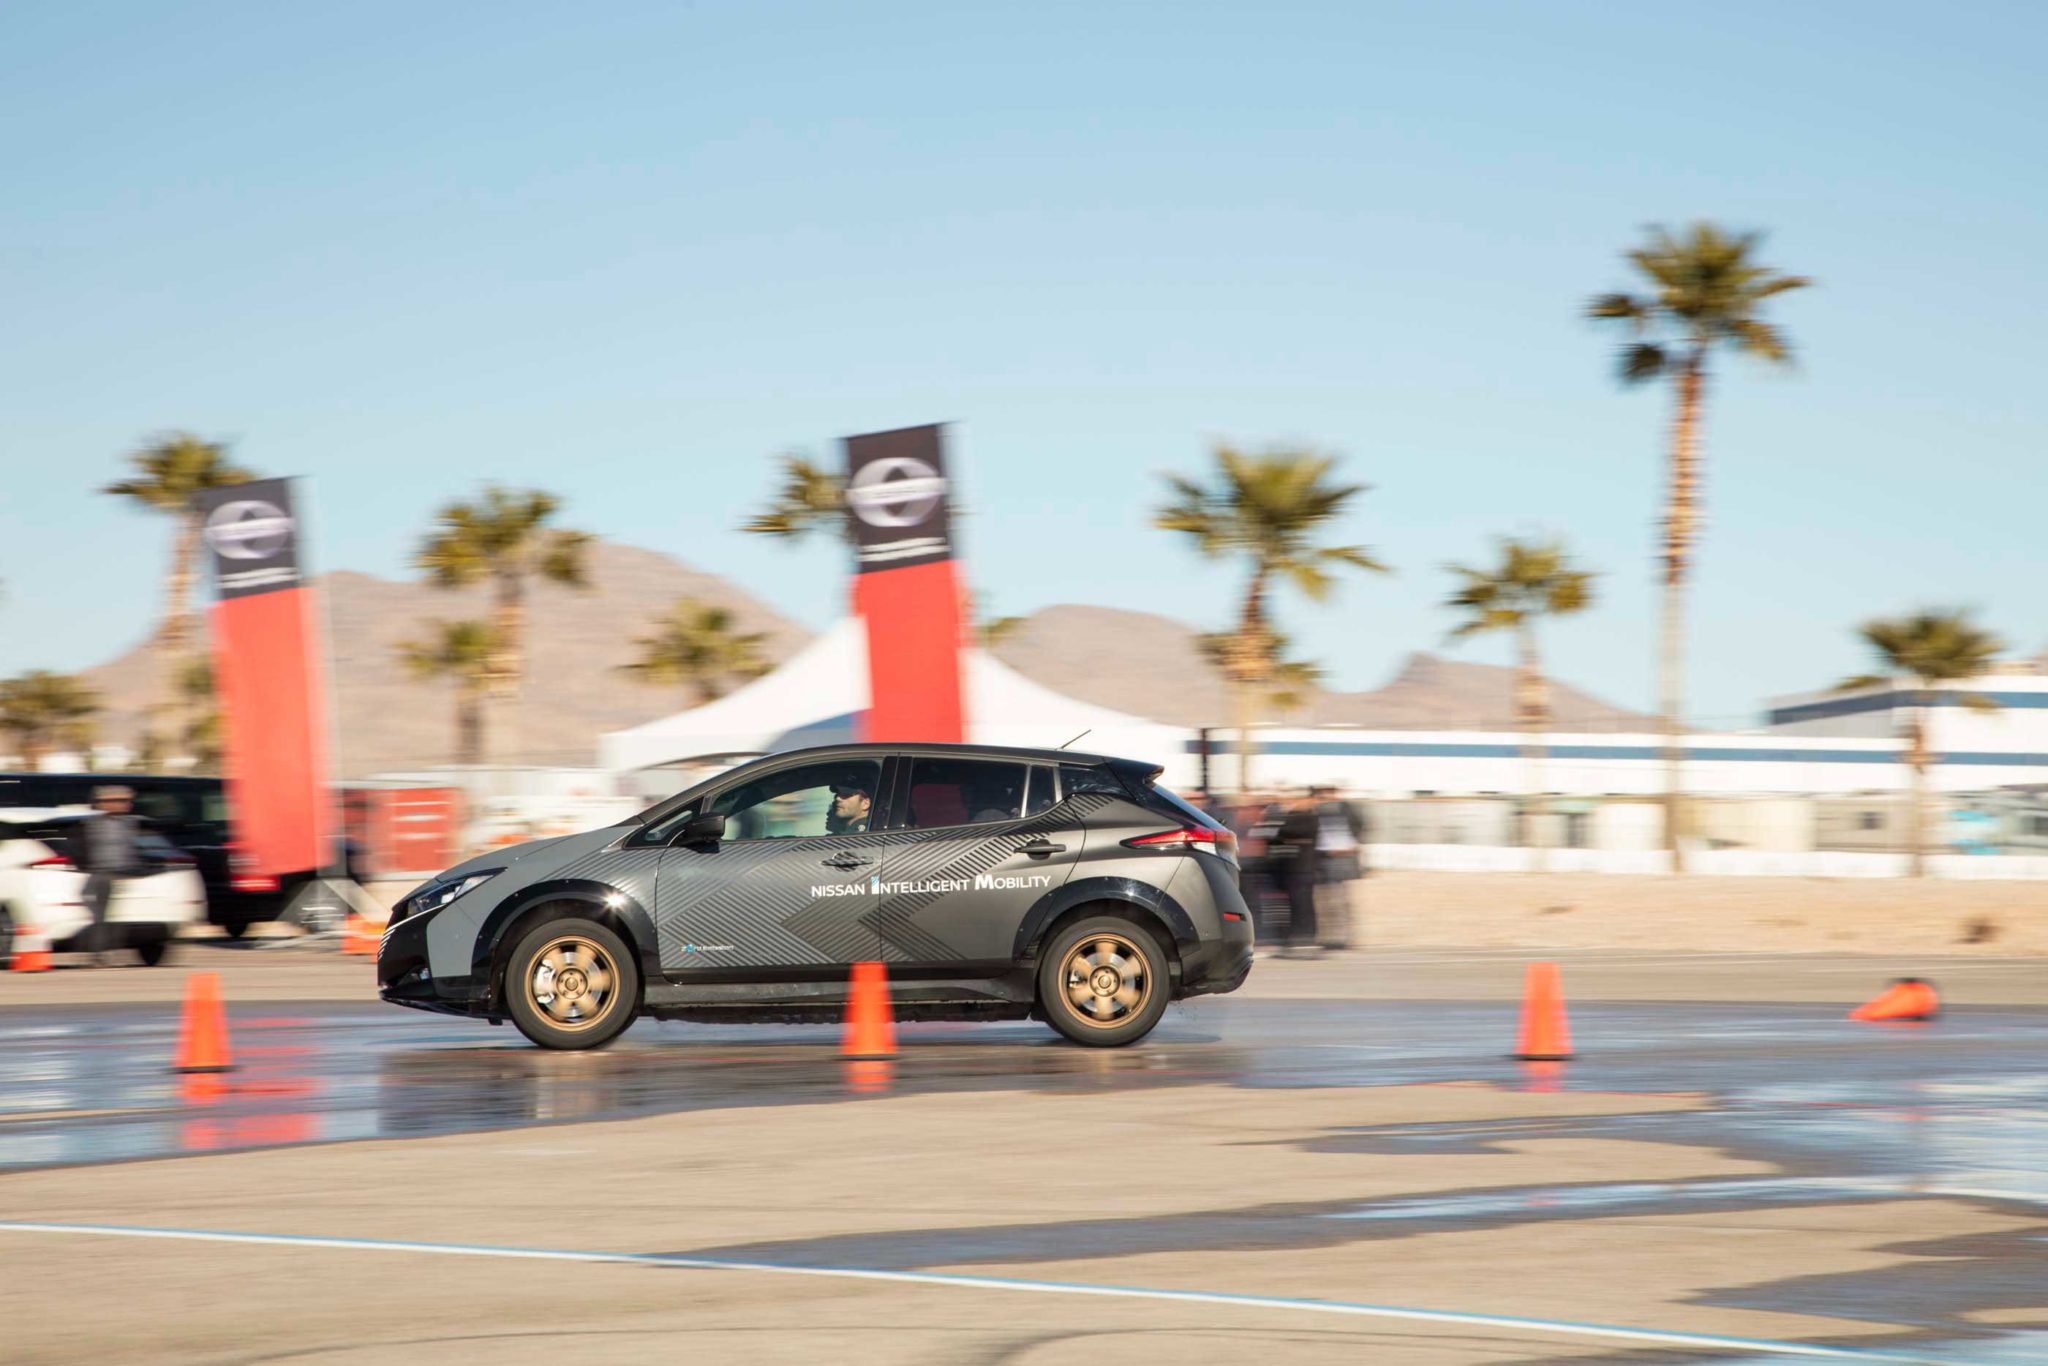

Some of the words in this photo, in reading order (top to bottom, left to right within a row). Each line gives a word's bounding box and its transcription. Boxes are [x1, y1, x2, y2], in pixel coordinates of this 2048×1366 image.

[811, 883, 865, 897] NISSAN
[871, 874, 970, 895] INTELLIGENT
[975, 874, 1051, 890] MOBILITY
